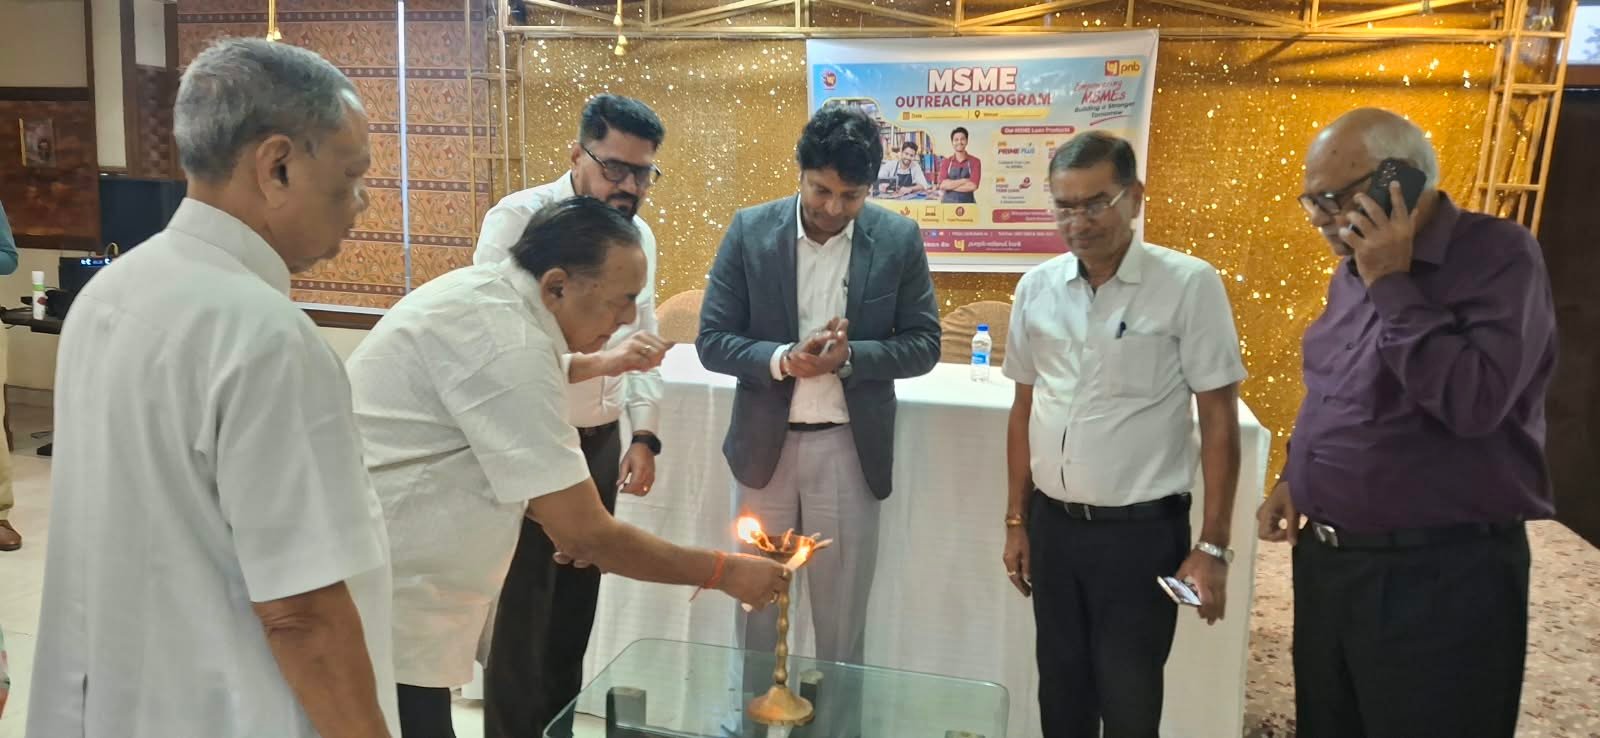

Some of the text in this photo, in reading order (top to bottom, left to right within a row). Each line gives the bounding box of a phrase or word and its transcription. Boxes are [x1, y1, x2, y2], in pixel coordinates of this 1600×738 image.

[1121, 61, 1140, 74] pnb
[928, 66, 1018, 93] MSME
[895, 94, 971, 108] OUTREACH
[976, 92, 1053, 107] PROGRAM
[1081, 89, 1127, 104] MSMEs
